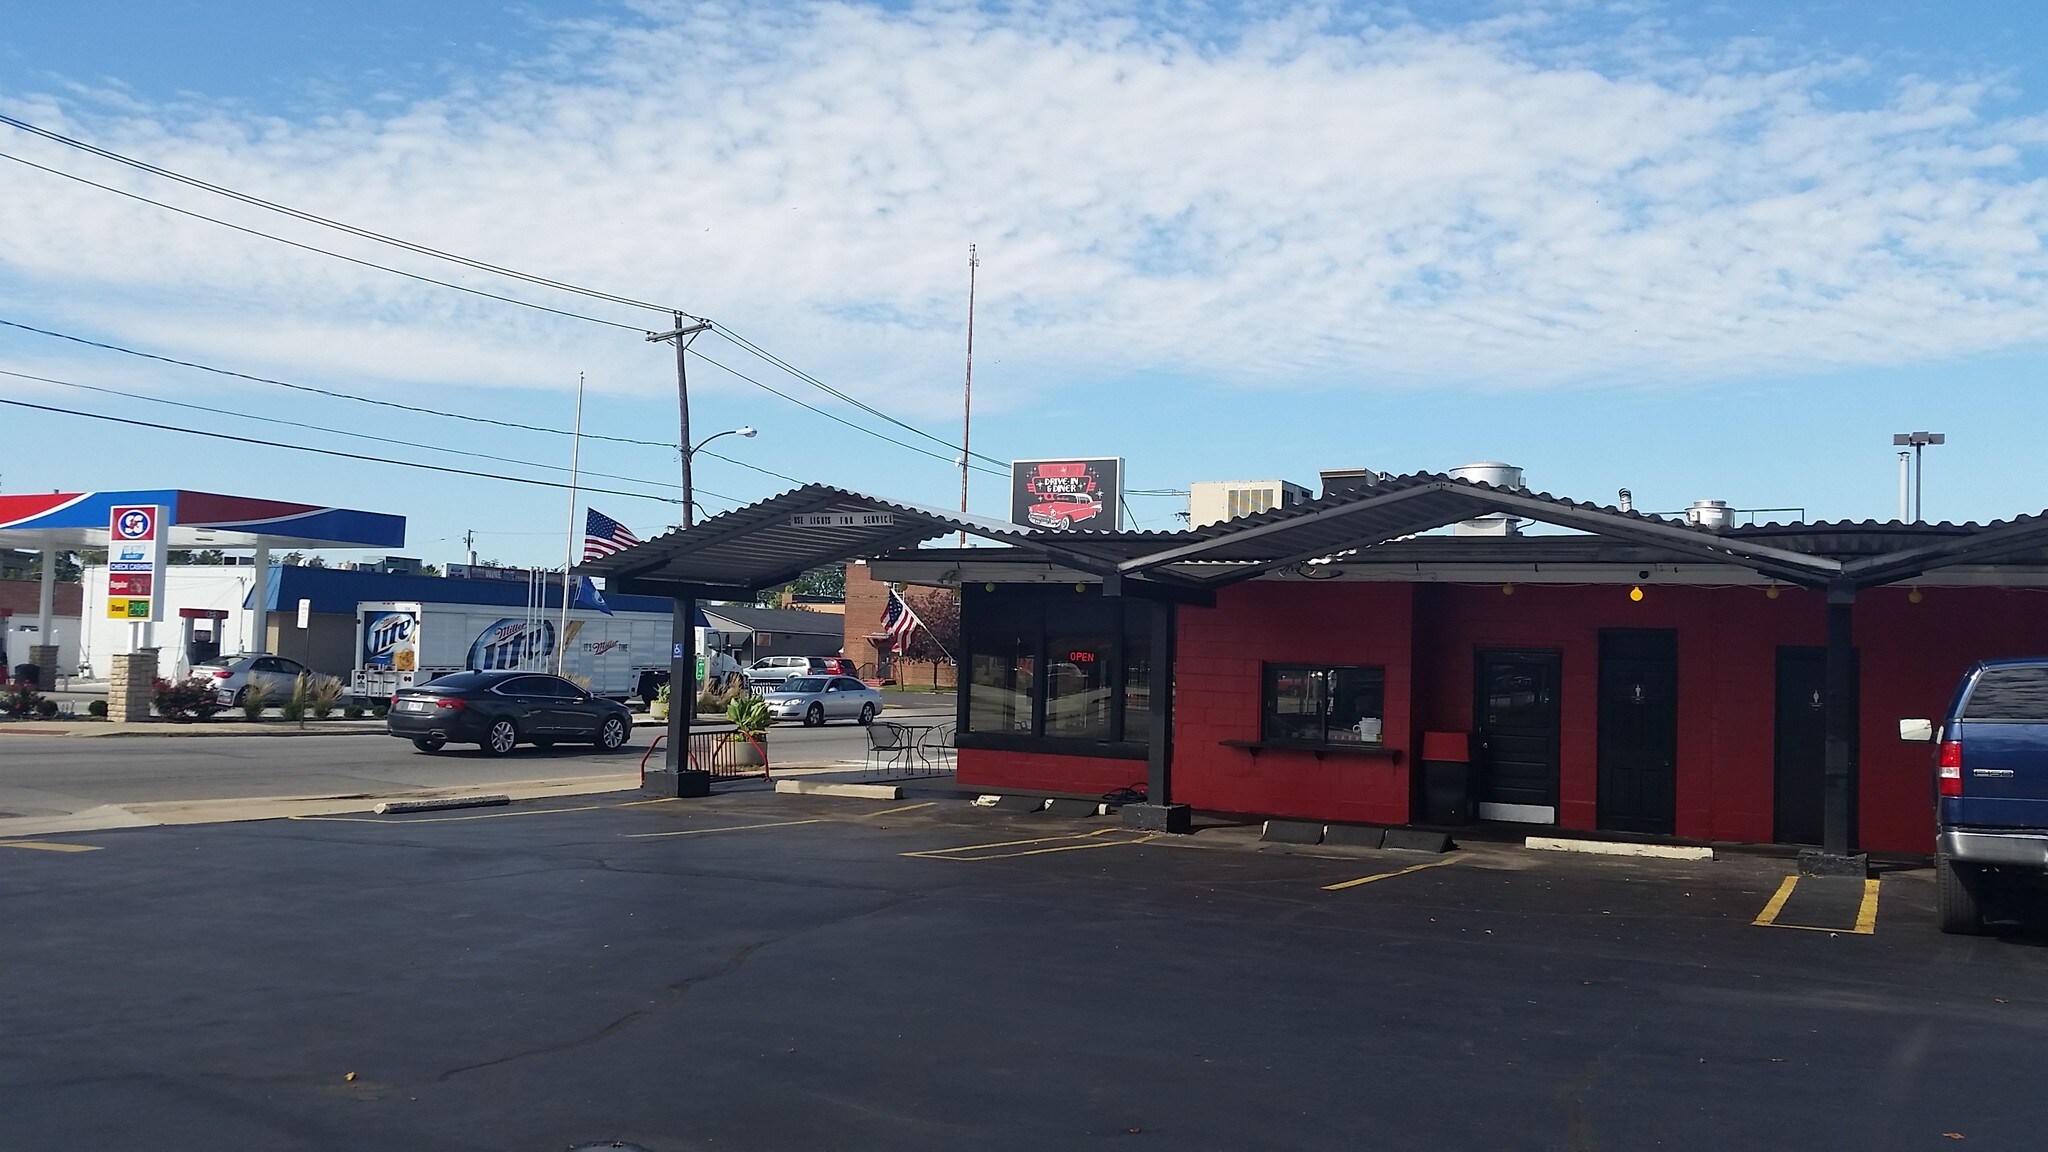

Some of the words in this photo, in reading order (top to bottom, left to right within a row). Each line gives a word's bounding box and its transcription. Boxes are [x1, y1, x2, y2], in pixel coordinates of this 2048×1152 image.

[1053, 485, 1077, 493] DINER
[794, 516, 803, 525] USE
[840, 516, 853, 525] FOR
[863, 514, 893, 524] SERVICE
[592, 640, 619, 656] Miller
[1070, 651, 1095, 662] OPEN
[751, 685, 780, 694] YOUN
